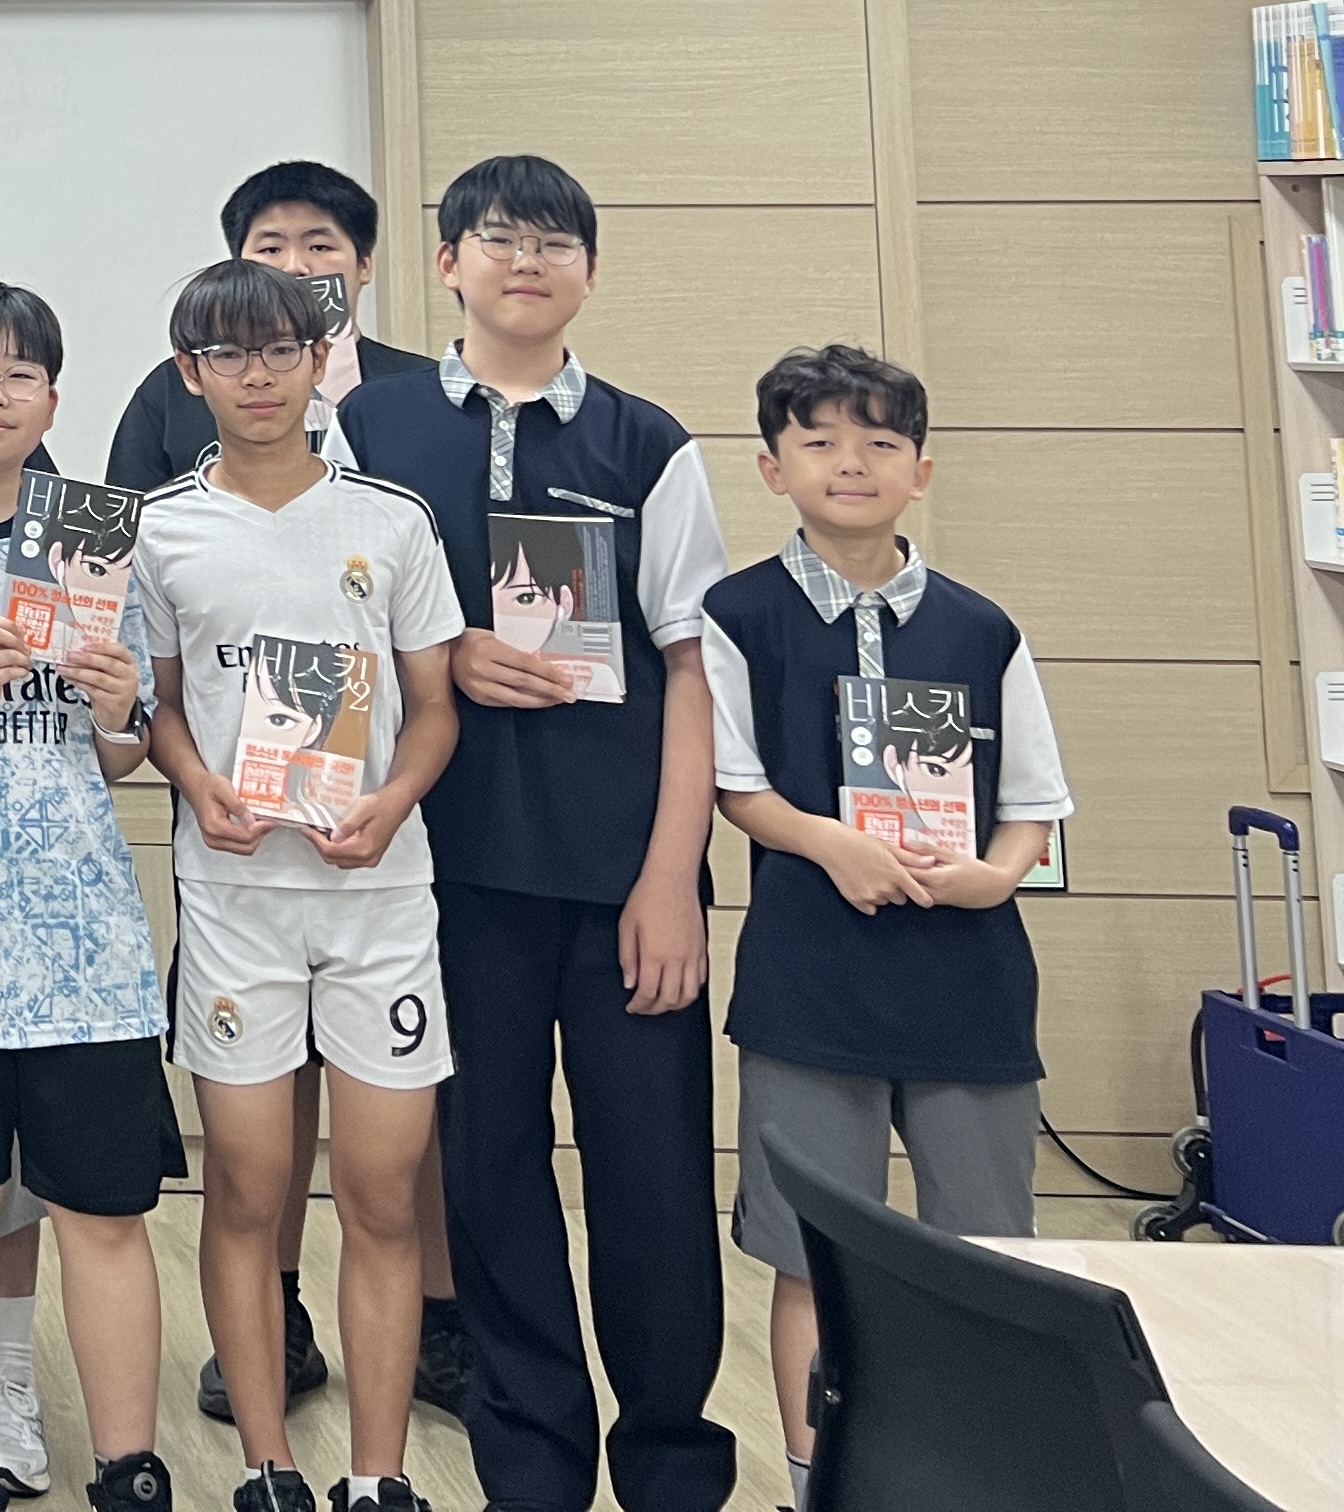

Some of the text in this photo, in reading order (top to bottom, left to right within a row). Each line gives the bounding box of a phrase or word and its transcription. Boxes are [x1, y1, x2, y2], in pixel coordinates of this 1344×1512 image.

[25, 476, 139, 539] 비스킷
[845, 682, 965, 735] 비스킷
[389, 993, 428, 1058] 9
